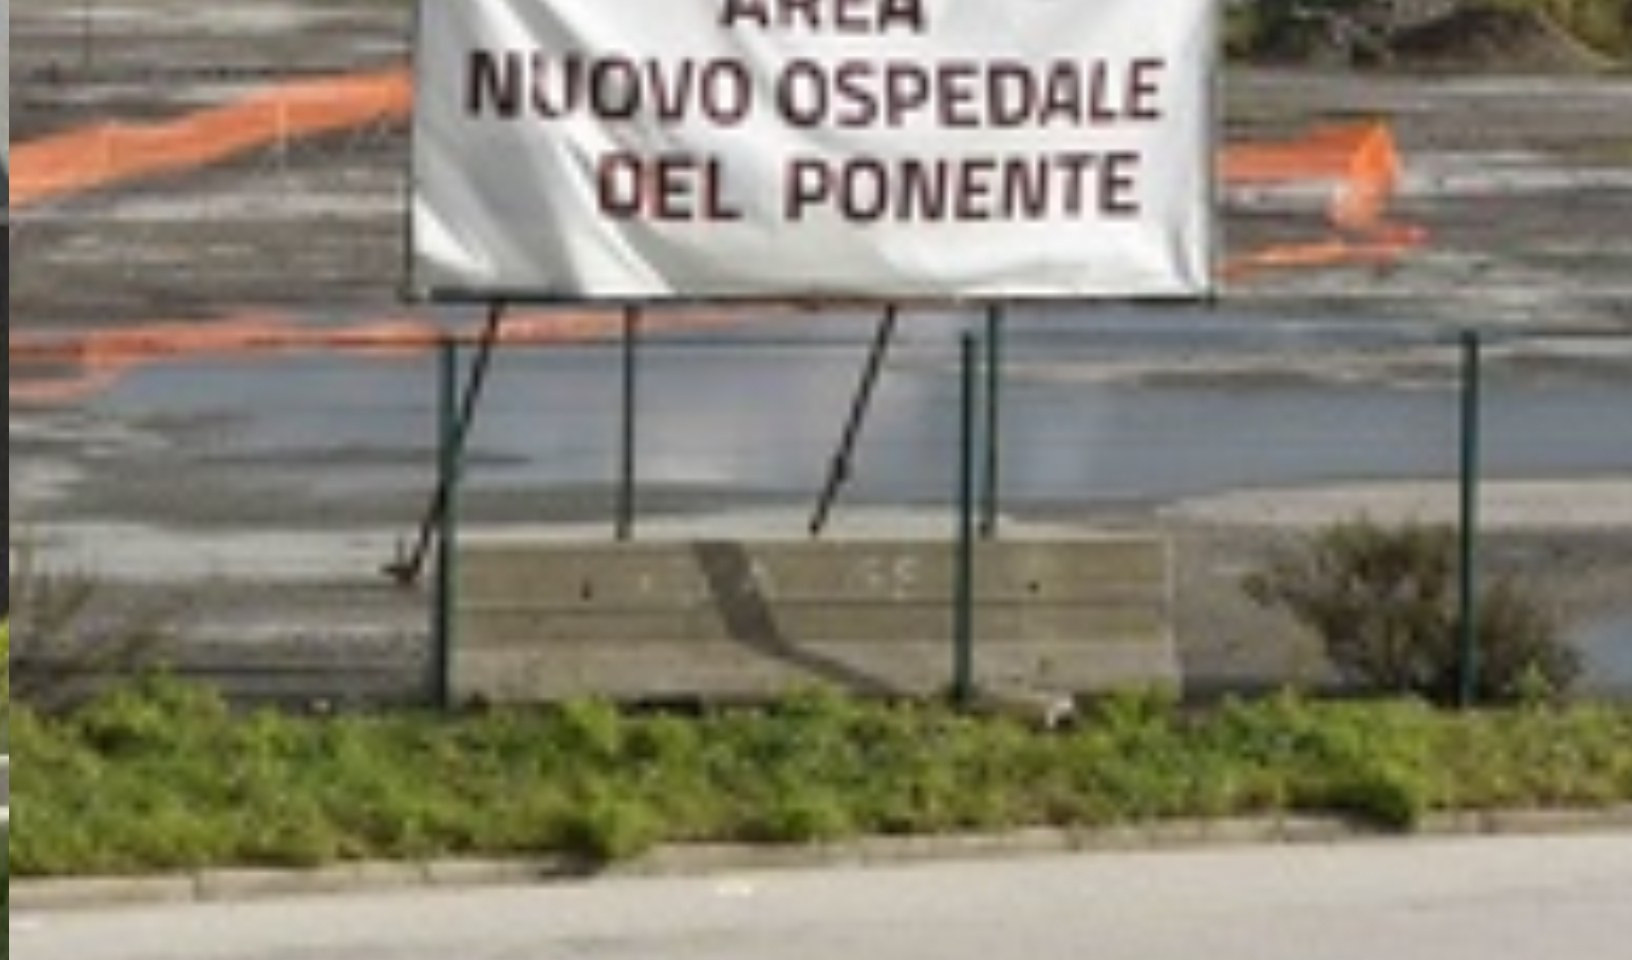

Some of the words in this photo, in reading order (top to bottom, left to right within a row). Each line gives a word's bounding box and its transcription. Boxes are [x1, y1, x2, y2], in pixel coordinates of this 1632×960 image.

[465, 49, 751, 123] NUOVO
[777, 58, 1166, 129] OSPEDALE
[596, 151, 742, 222] DEL
[784, 152, 1141, 223] PONENTE
